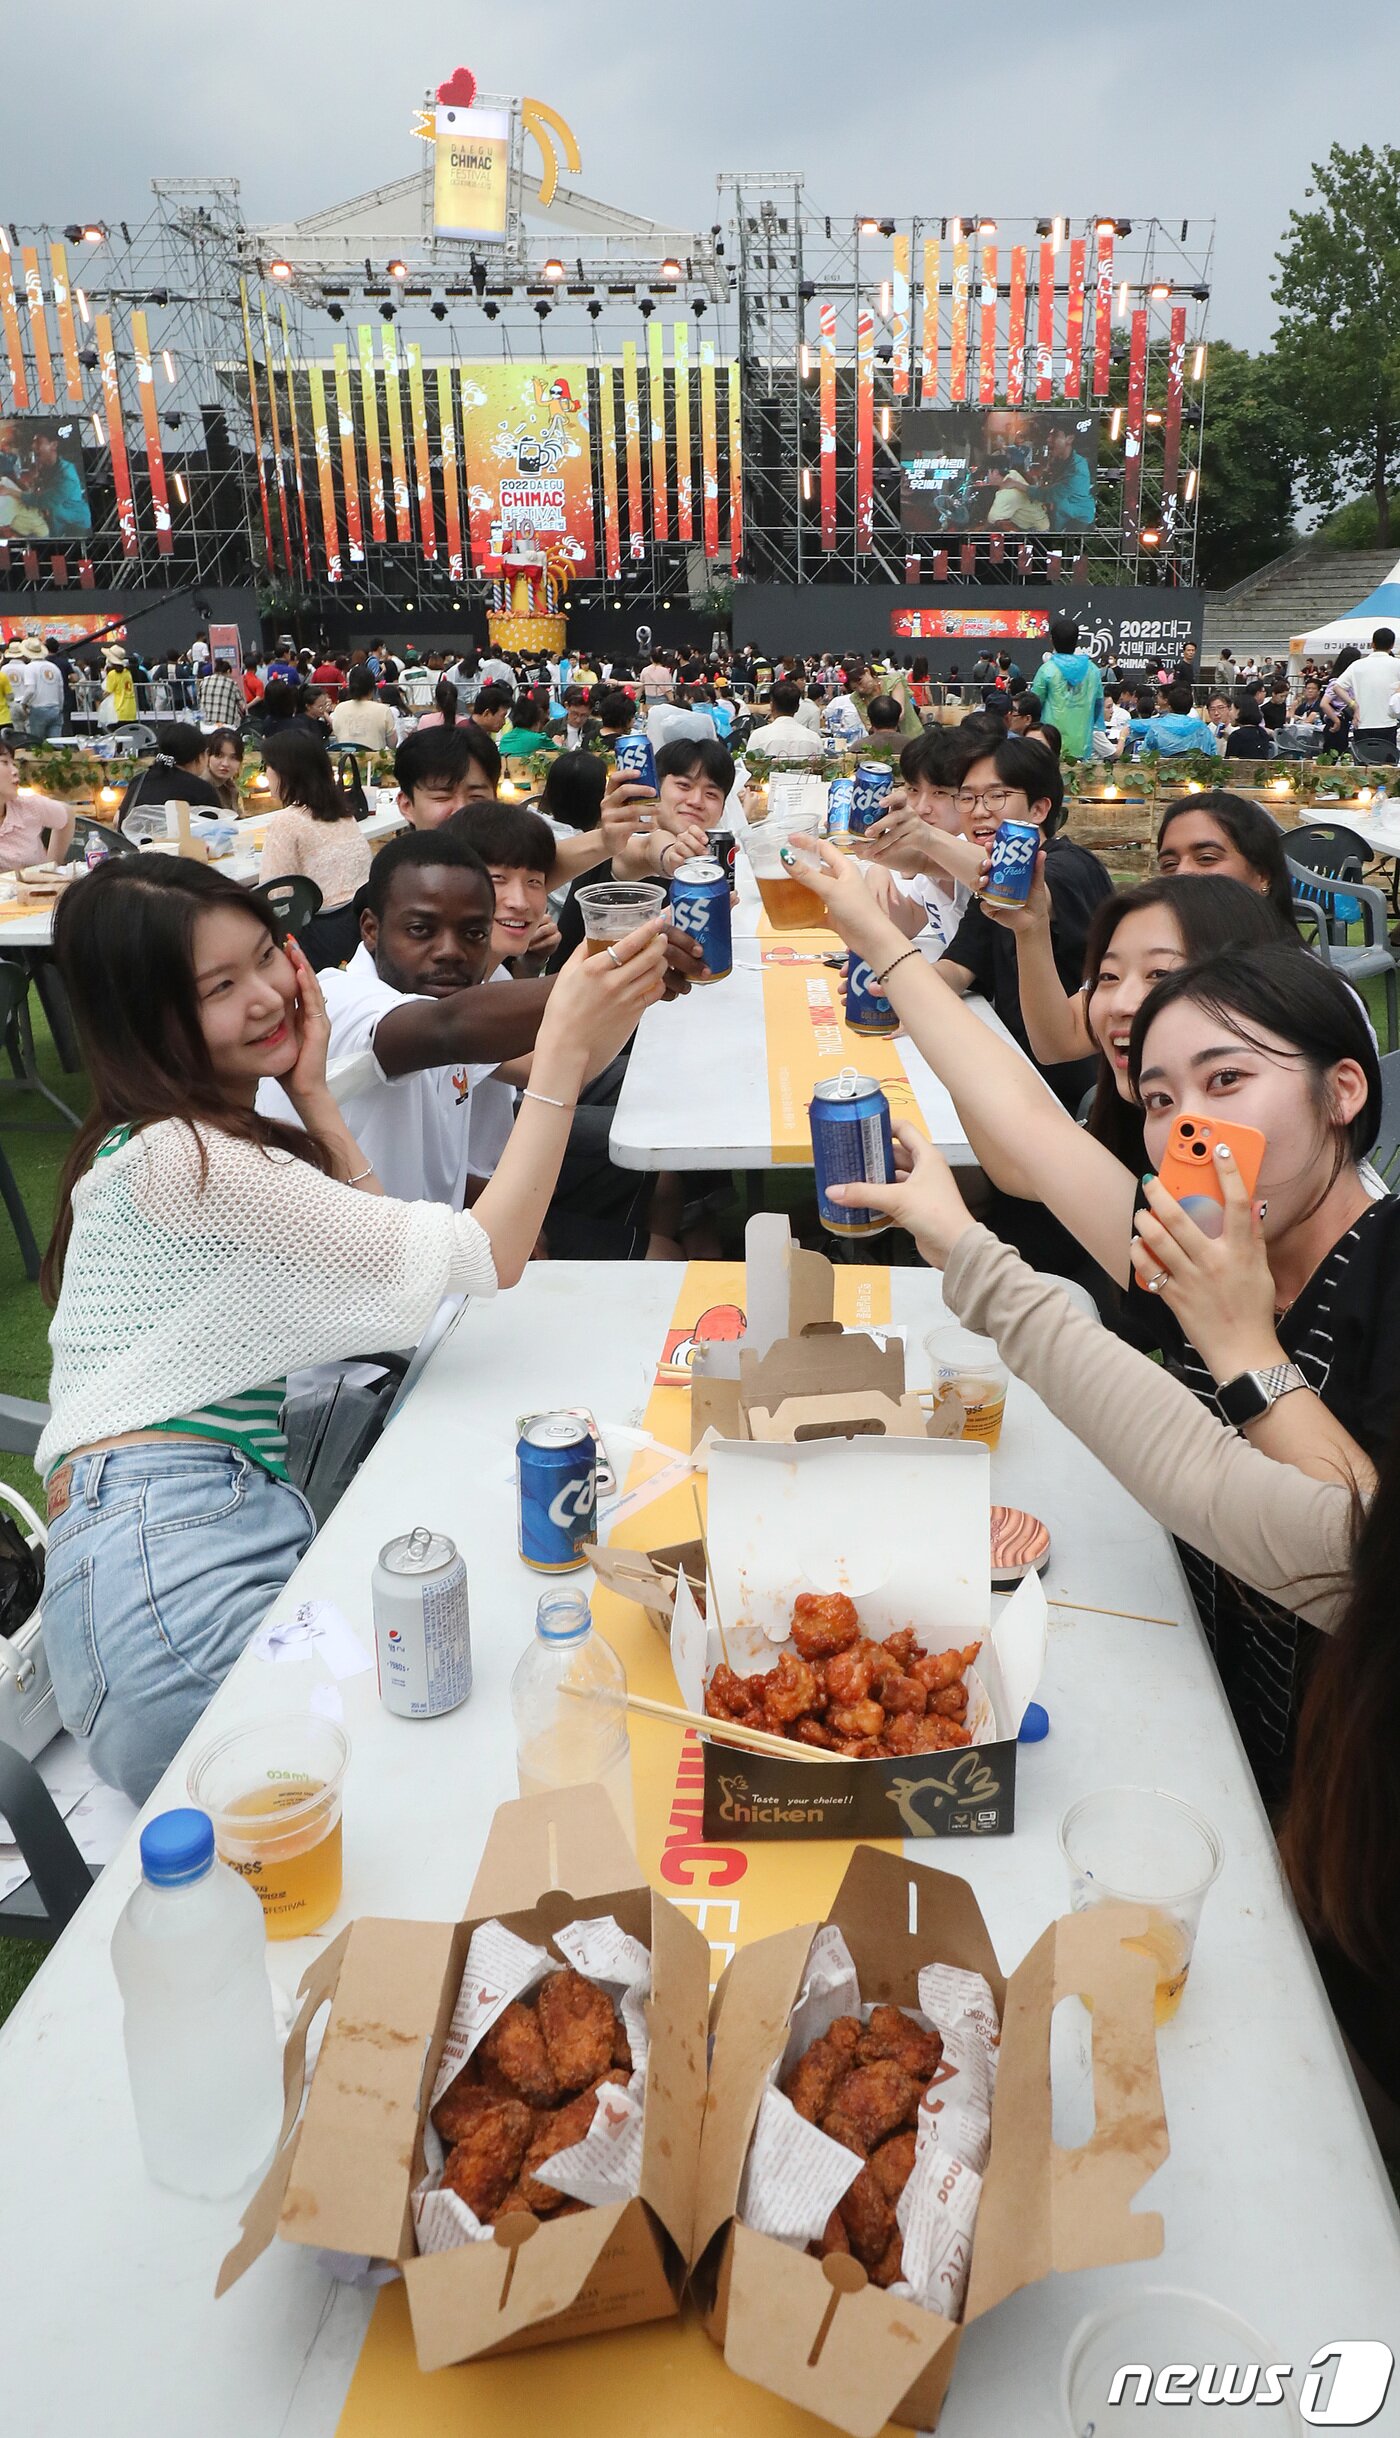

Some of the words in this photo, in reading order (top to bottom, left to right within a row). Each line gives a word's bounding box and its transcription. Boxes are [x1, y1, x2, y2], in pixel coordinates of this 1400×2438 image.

[451, 144, 492, 155] DAEGU
[451, 154, 492, 170] CHIMAC
[501, 481, 528, 490] 2022
[530, 481, 563, 490] DAEGU
[501, 491, 563, 507] CHIMAC
[502, 508, 563, 521] FESTIVAL
[1120, 621, 1160, 638] 2022
[1162, 620, 1192, 638] 대구
[1117, 659, 1149, 669] CHIMAC
[1003, 866, 1027, 877] Fresh
[813, 1026, 846, 1057] FESTIVAL
[751, 1794, 779, 1804] Taste
[787, 1796, 809, 1806] your
[813, 1794, 853, 1805] choice!!
[719, 1804, 824, 1823] Chicken
